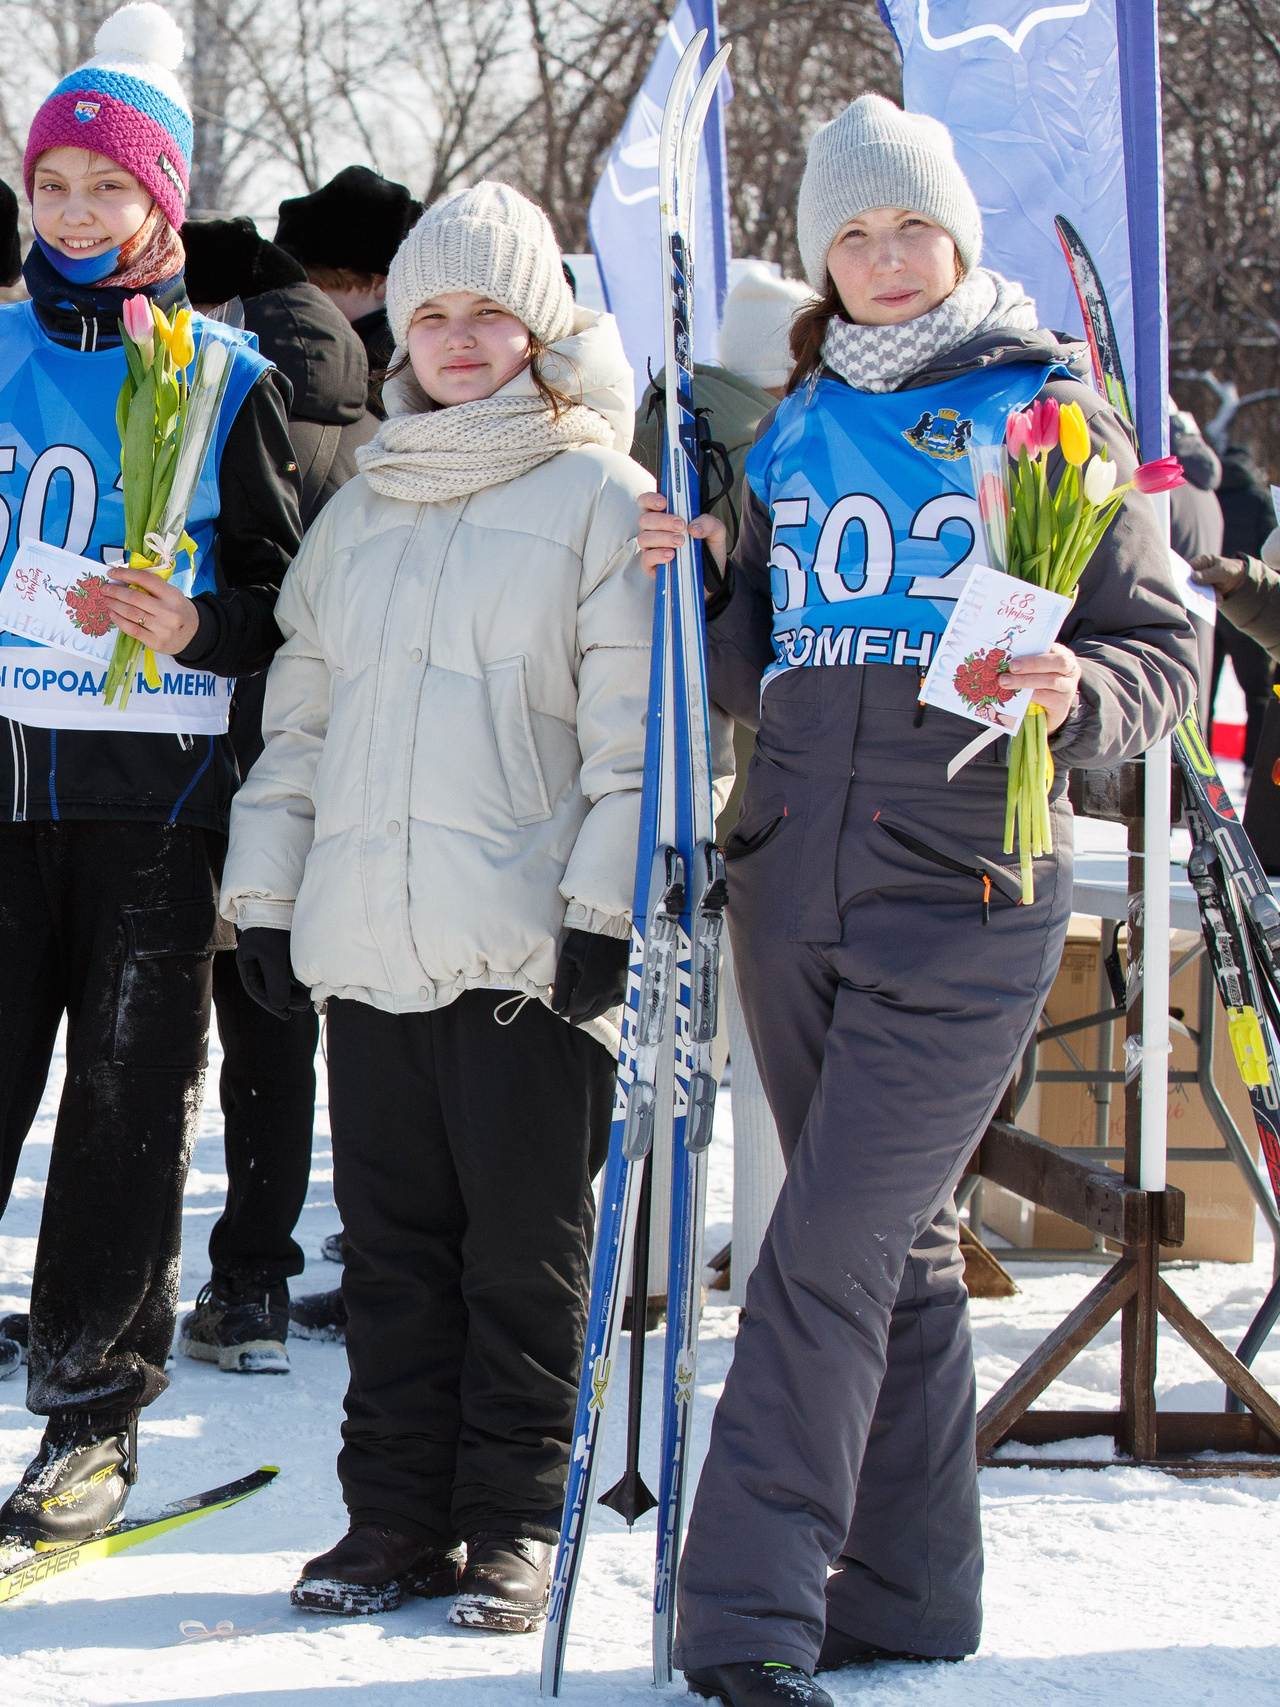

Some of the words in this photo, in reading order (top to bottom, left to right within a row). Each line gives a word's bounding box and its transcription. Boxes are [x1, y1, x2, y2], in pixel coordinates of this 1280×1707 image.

[769, 491, 988, 614] 502
[773, 623, 944, 668] ТЮМЕН
[611, 922, 646, 1122] ALPHA
[673, 922, 692, 1119] ALPHA
[41, 1462, 117, 1514] FISCHER
[8, 1550, 81, 1596] FISCHER
